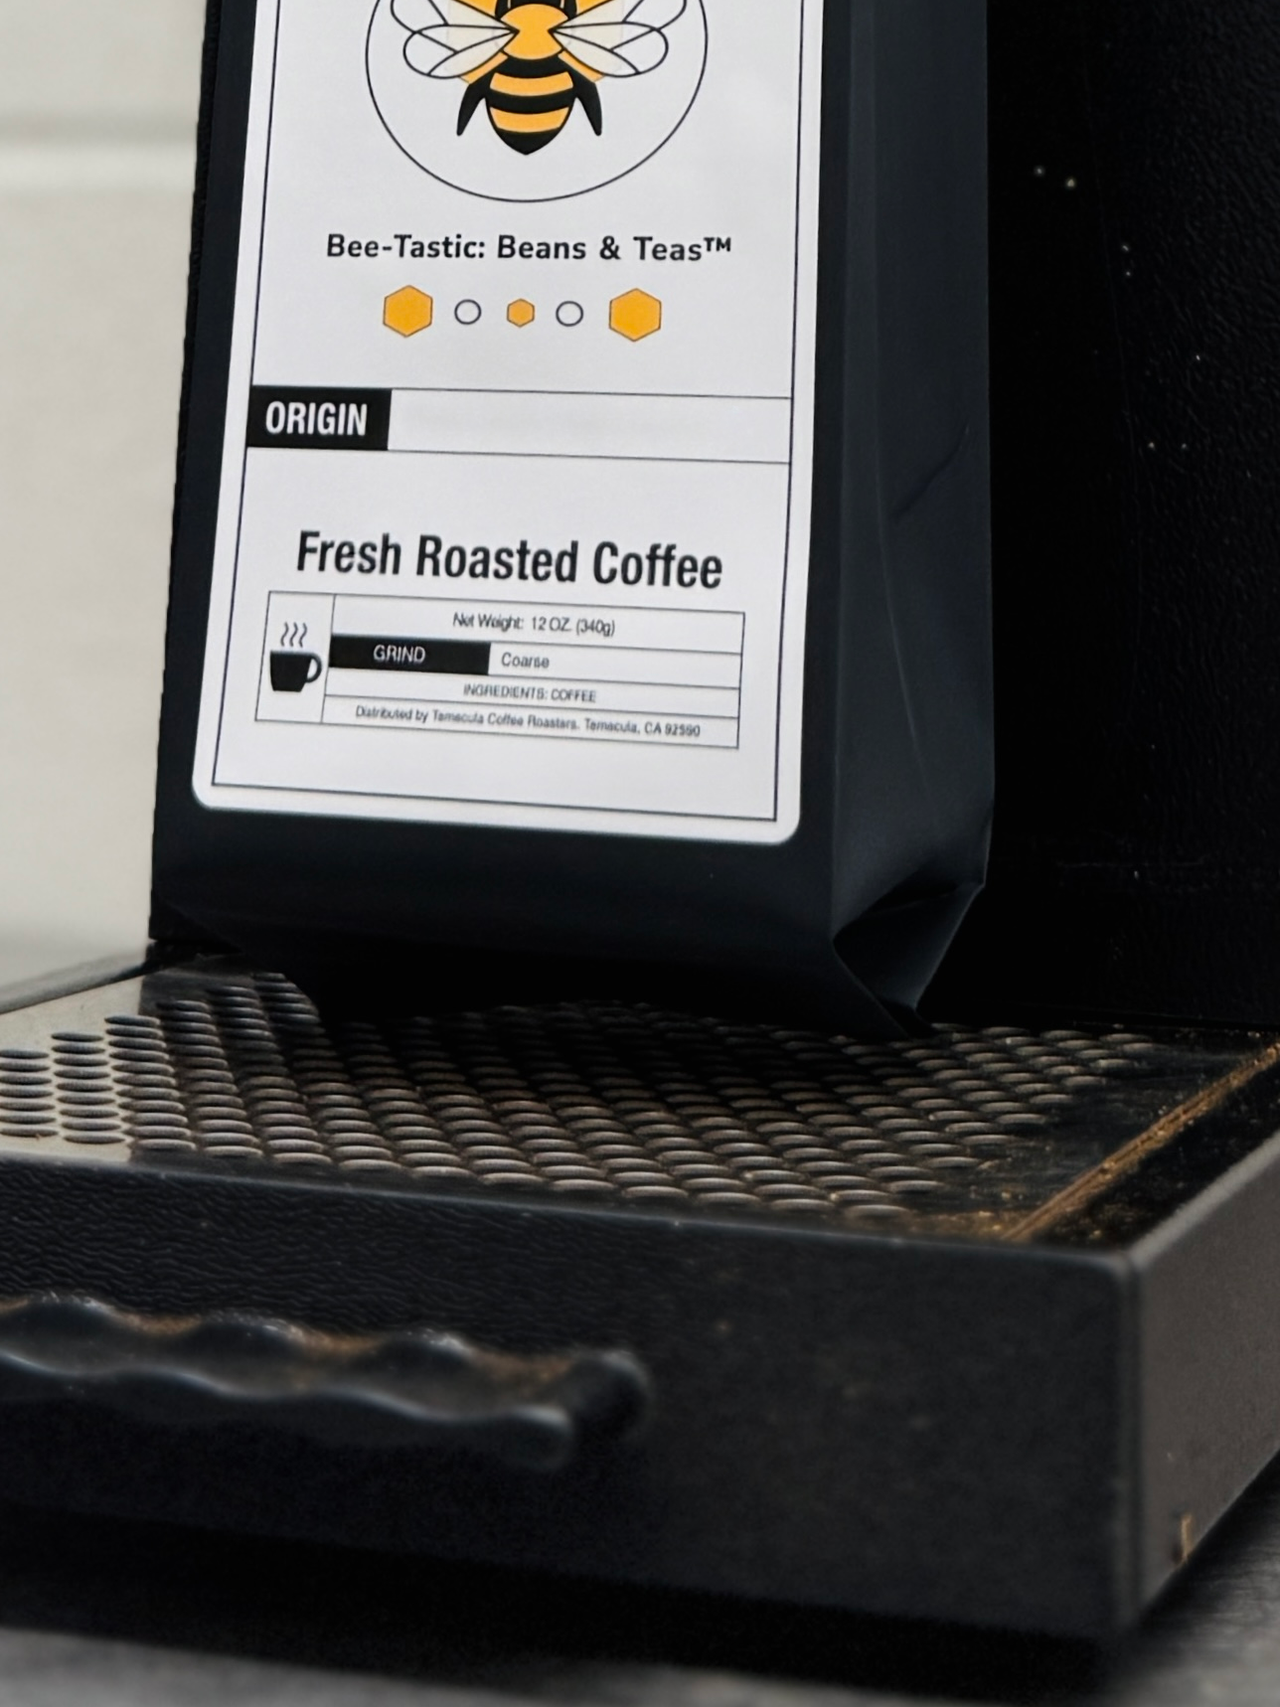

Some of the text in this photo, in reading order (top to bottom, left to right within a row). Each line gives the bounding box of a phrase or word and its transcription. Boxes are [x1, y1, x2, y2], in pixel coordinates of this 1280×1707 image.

[326, 233, 486, 259] Bee-Tastic:
[497, 234, 587, 260] Beans
[598, 235, 622, 260] &
[265, 400, 368, 436] ORIGIN
[296, 529, 723, 589] Fresh Roasted Coffee
[452, 611, 475, 628] Net
[531, 616, 547, 631] 12
[576, 618, 616, 637] (340g)
[372, 643, 551, 669] GRIND Coarse
[463, 683, 597, 703] INGREDIENTS: COFFEE
[355, 705, 413, 721] Distributed
[415, 709, 429, 723] by
[487, 712, 524, 727] Coffee
[644, 721, 662, 735] CA
